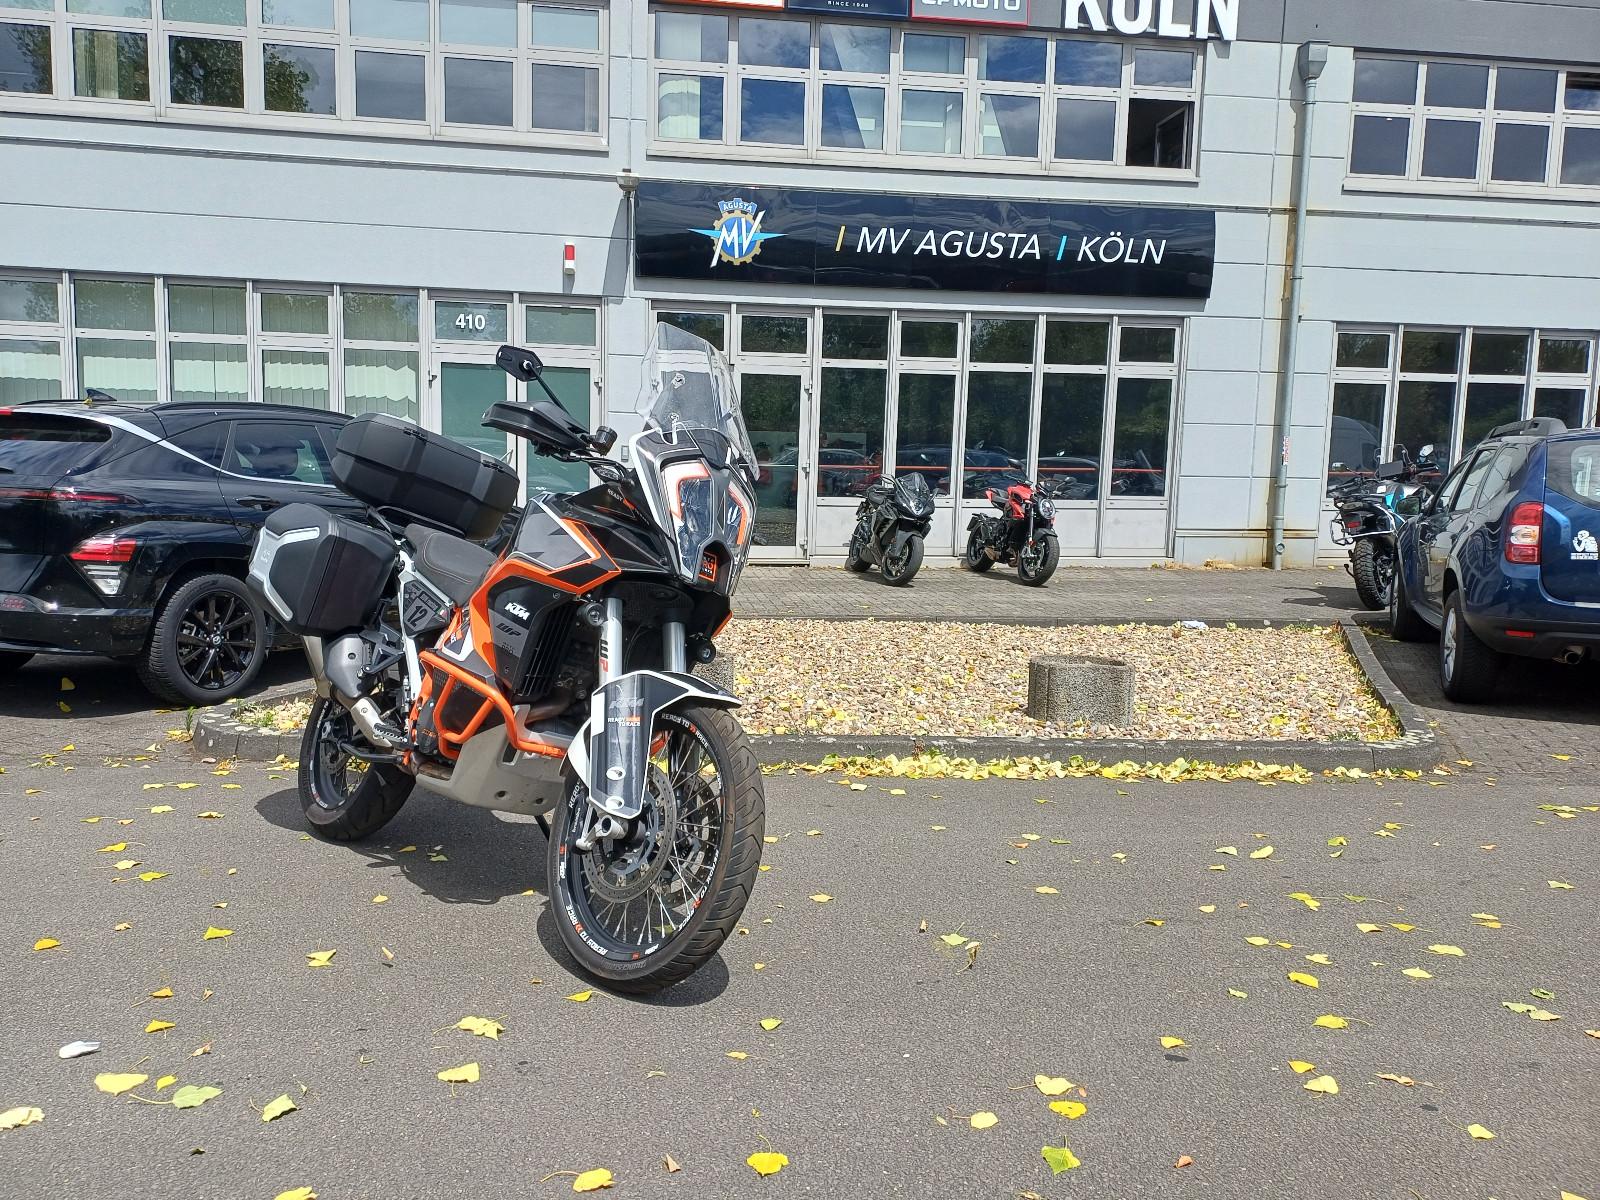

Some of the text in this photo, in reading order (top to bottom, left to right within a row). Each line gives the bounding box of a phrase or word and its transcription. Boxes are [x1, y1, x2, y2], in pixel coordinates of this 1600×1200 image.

[827, 0, 850, 8] SINCE
[723, 201, 754, 211] AGUSTA
[710, 210, 766, 268] MV
[856, 226, 1167, 264] MV AGUSTA KÖLN
[455, 313, 486, 330] 410
[407, 605, 428, 628] 12
[504, 602, 531, 621] KTM
[495, 622, 522, 637] WP
[661, 712, 681, 724] READY
[680, 718, 690, 728] TO
[565, 904, 609, 956] READY TO RACE
